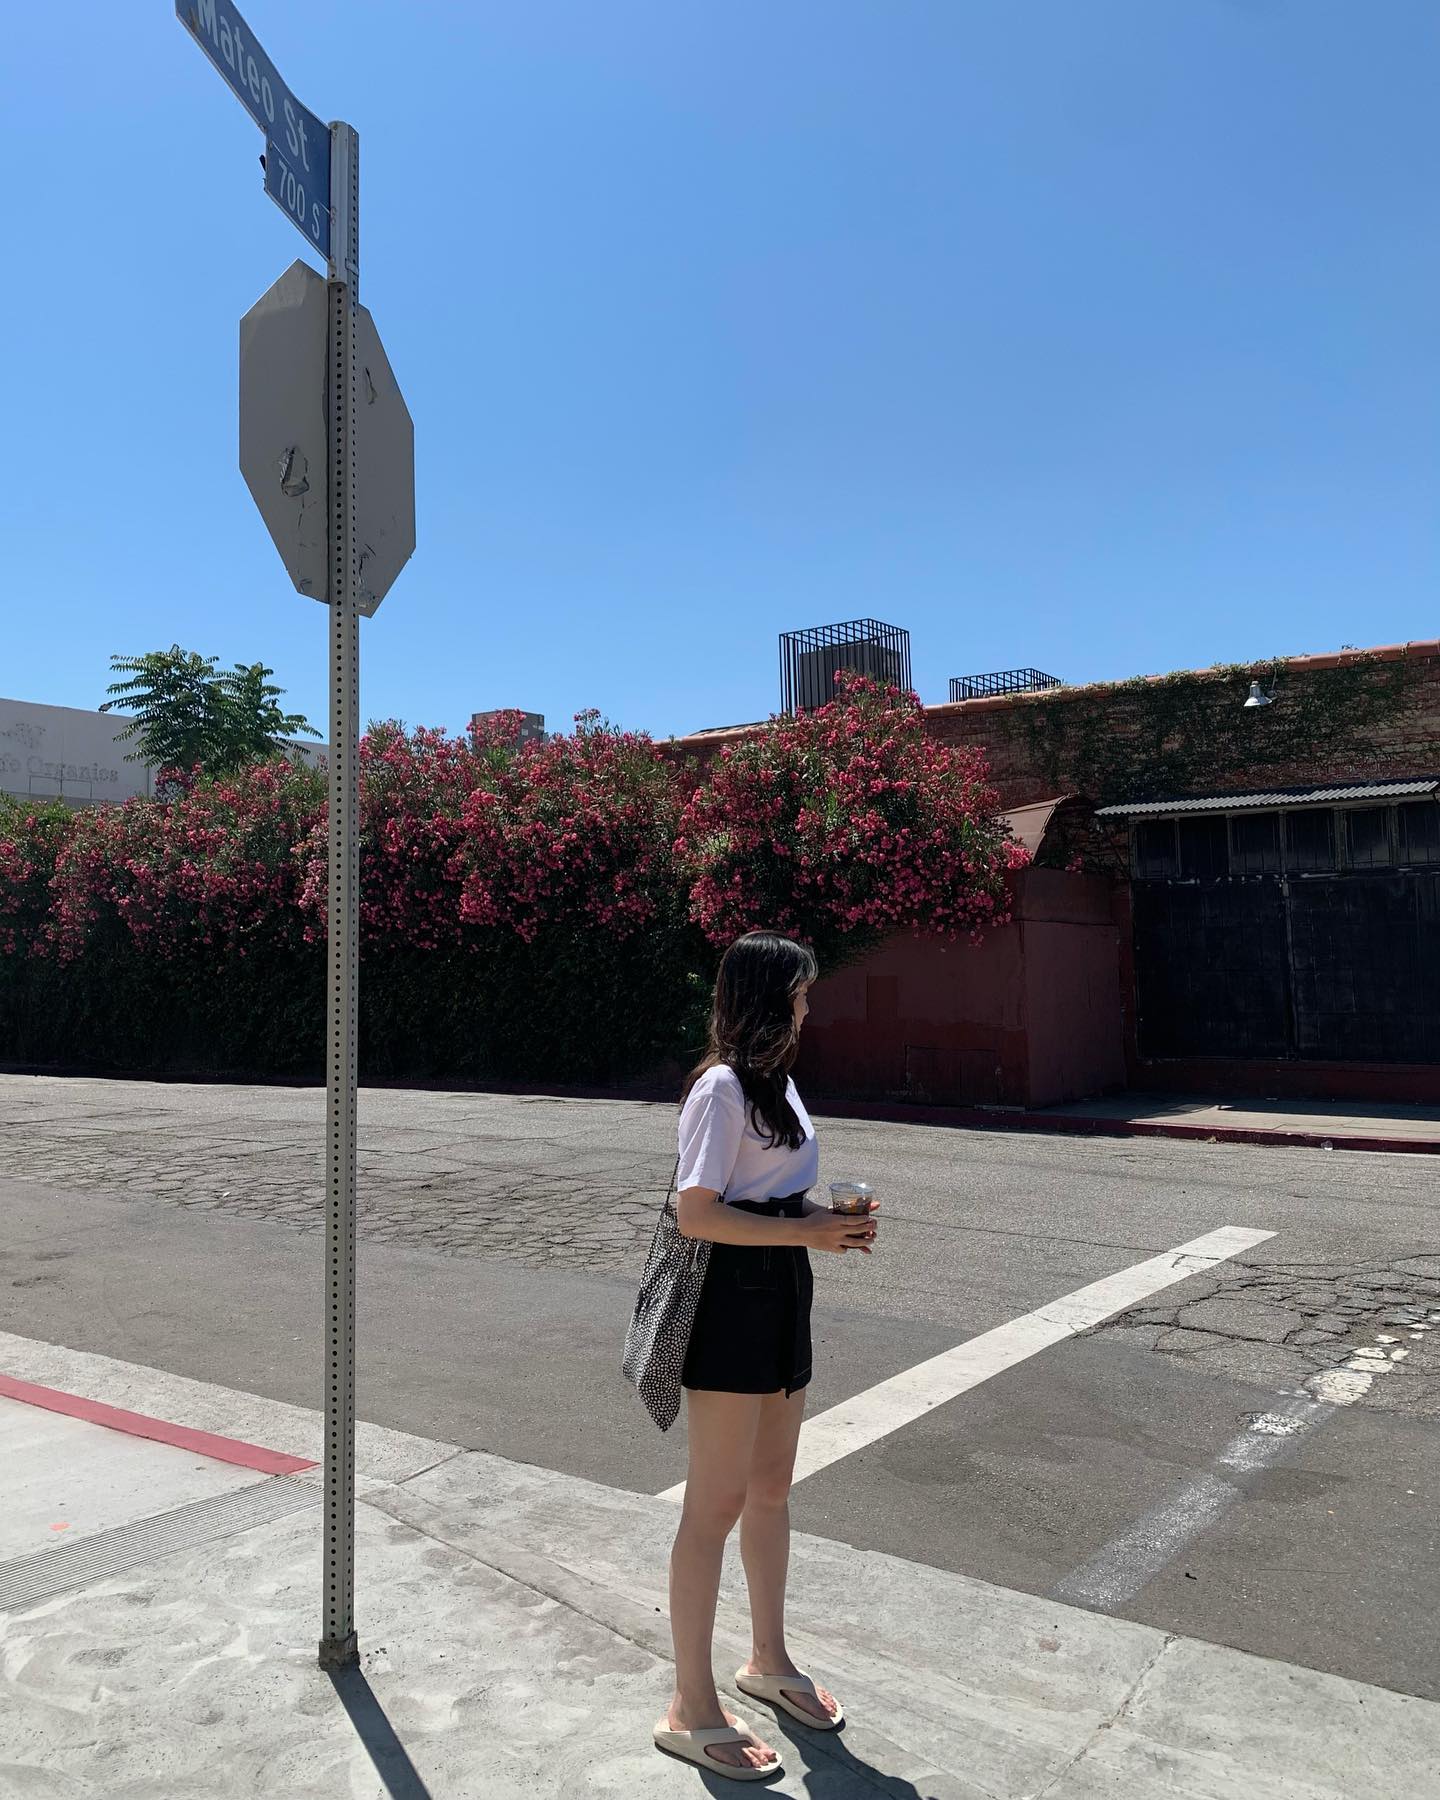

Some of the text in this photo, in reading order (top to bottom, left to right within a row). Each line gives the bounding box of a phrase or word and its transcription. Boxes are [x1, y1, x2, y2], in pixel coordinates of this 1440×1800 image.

[196, 0, 310, 172] Mateo St
[278, 159, 320, 240] 700 S
